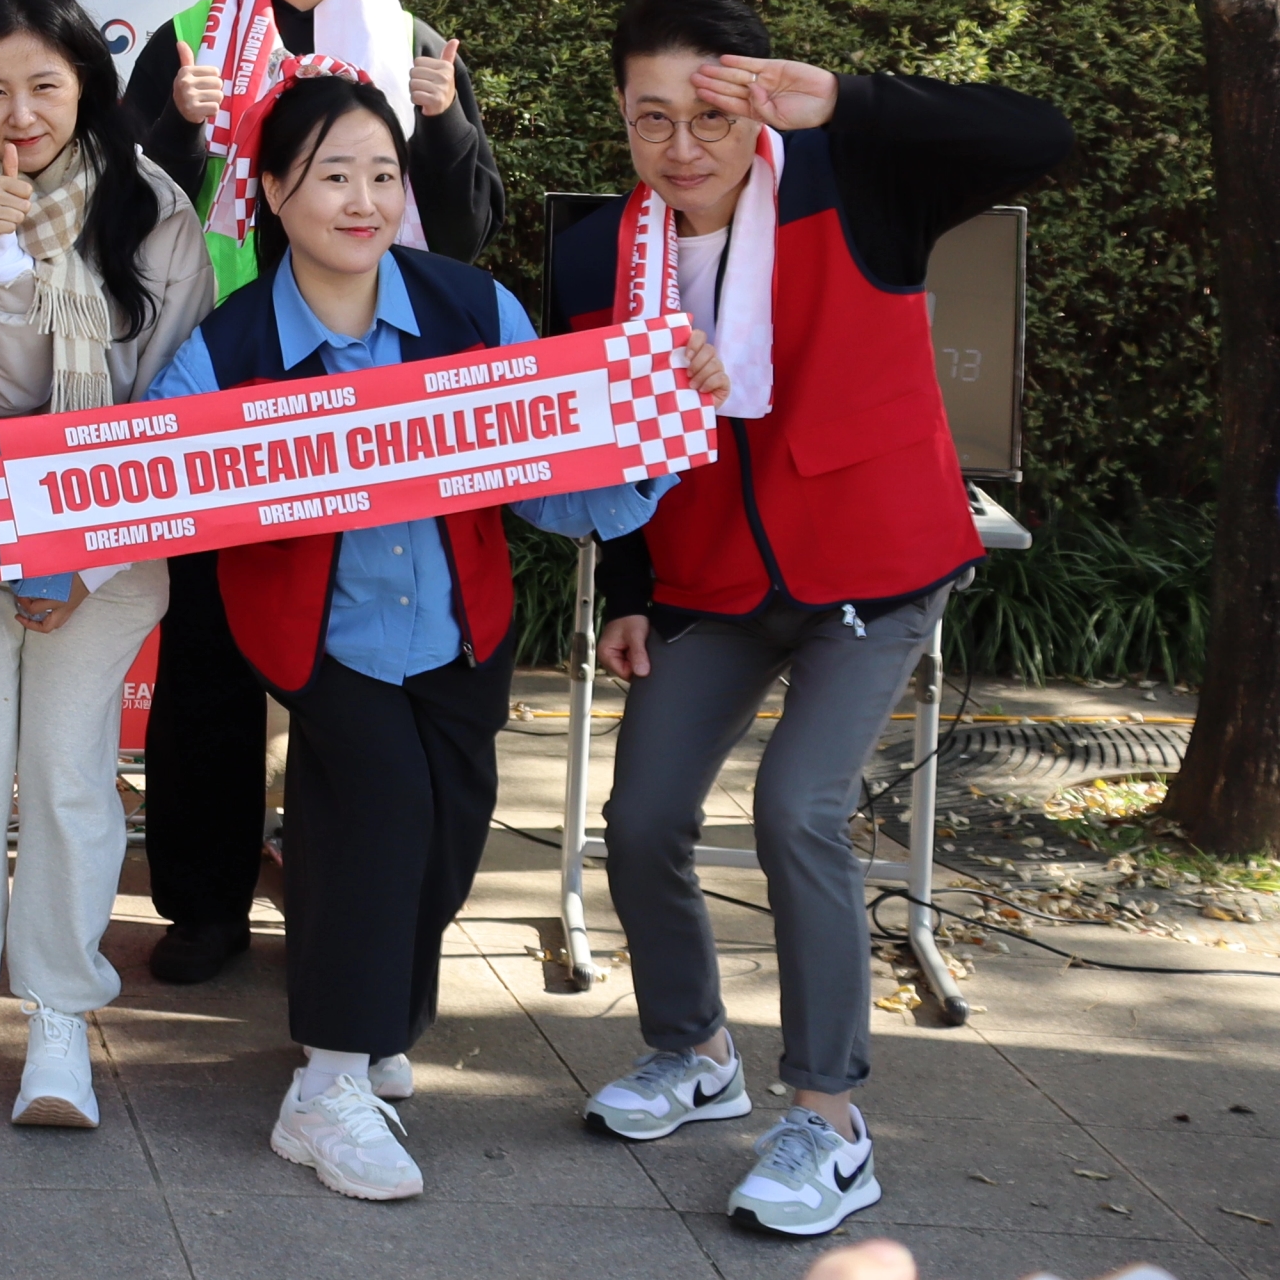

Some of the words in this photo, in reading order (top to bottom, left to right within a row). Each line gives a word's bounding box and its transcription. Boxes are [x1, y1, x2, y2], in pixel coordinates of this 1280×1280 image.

[242, 14, 269, 62] DREAM
[233, 61, 256, 96] PLUS
[424, 363, 490, 393] DREAM
[493, 355, 538, 381] PLUS
[242, 395, 308, 421] DREAM
[310, 386, 356, 411] PLUS
[64, 420, 131, 447] DREAM
[133, 413, 178, 439] PLUS
[38, 455, 178, 515] 10000
[183, 431, 340, 496] DREAM
[345, 390, 581, 470] CHALLENGE
[438, 469, 504, 498] DREAM
[506, 460, 552, 487] PLUS
[258, 497, 324, 526] DREAM
[326, 491, 371, 516] PLUS
[84, 524, 149, 552] DREAM
[151, 517, 196, 544] PLUS
